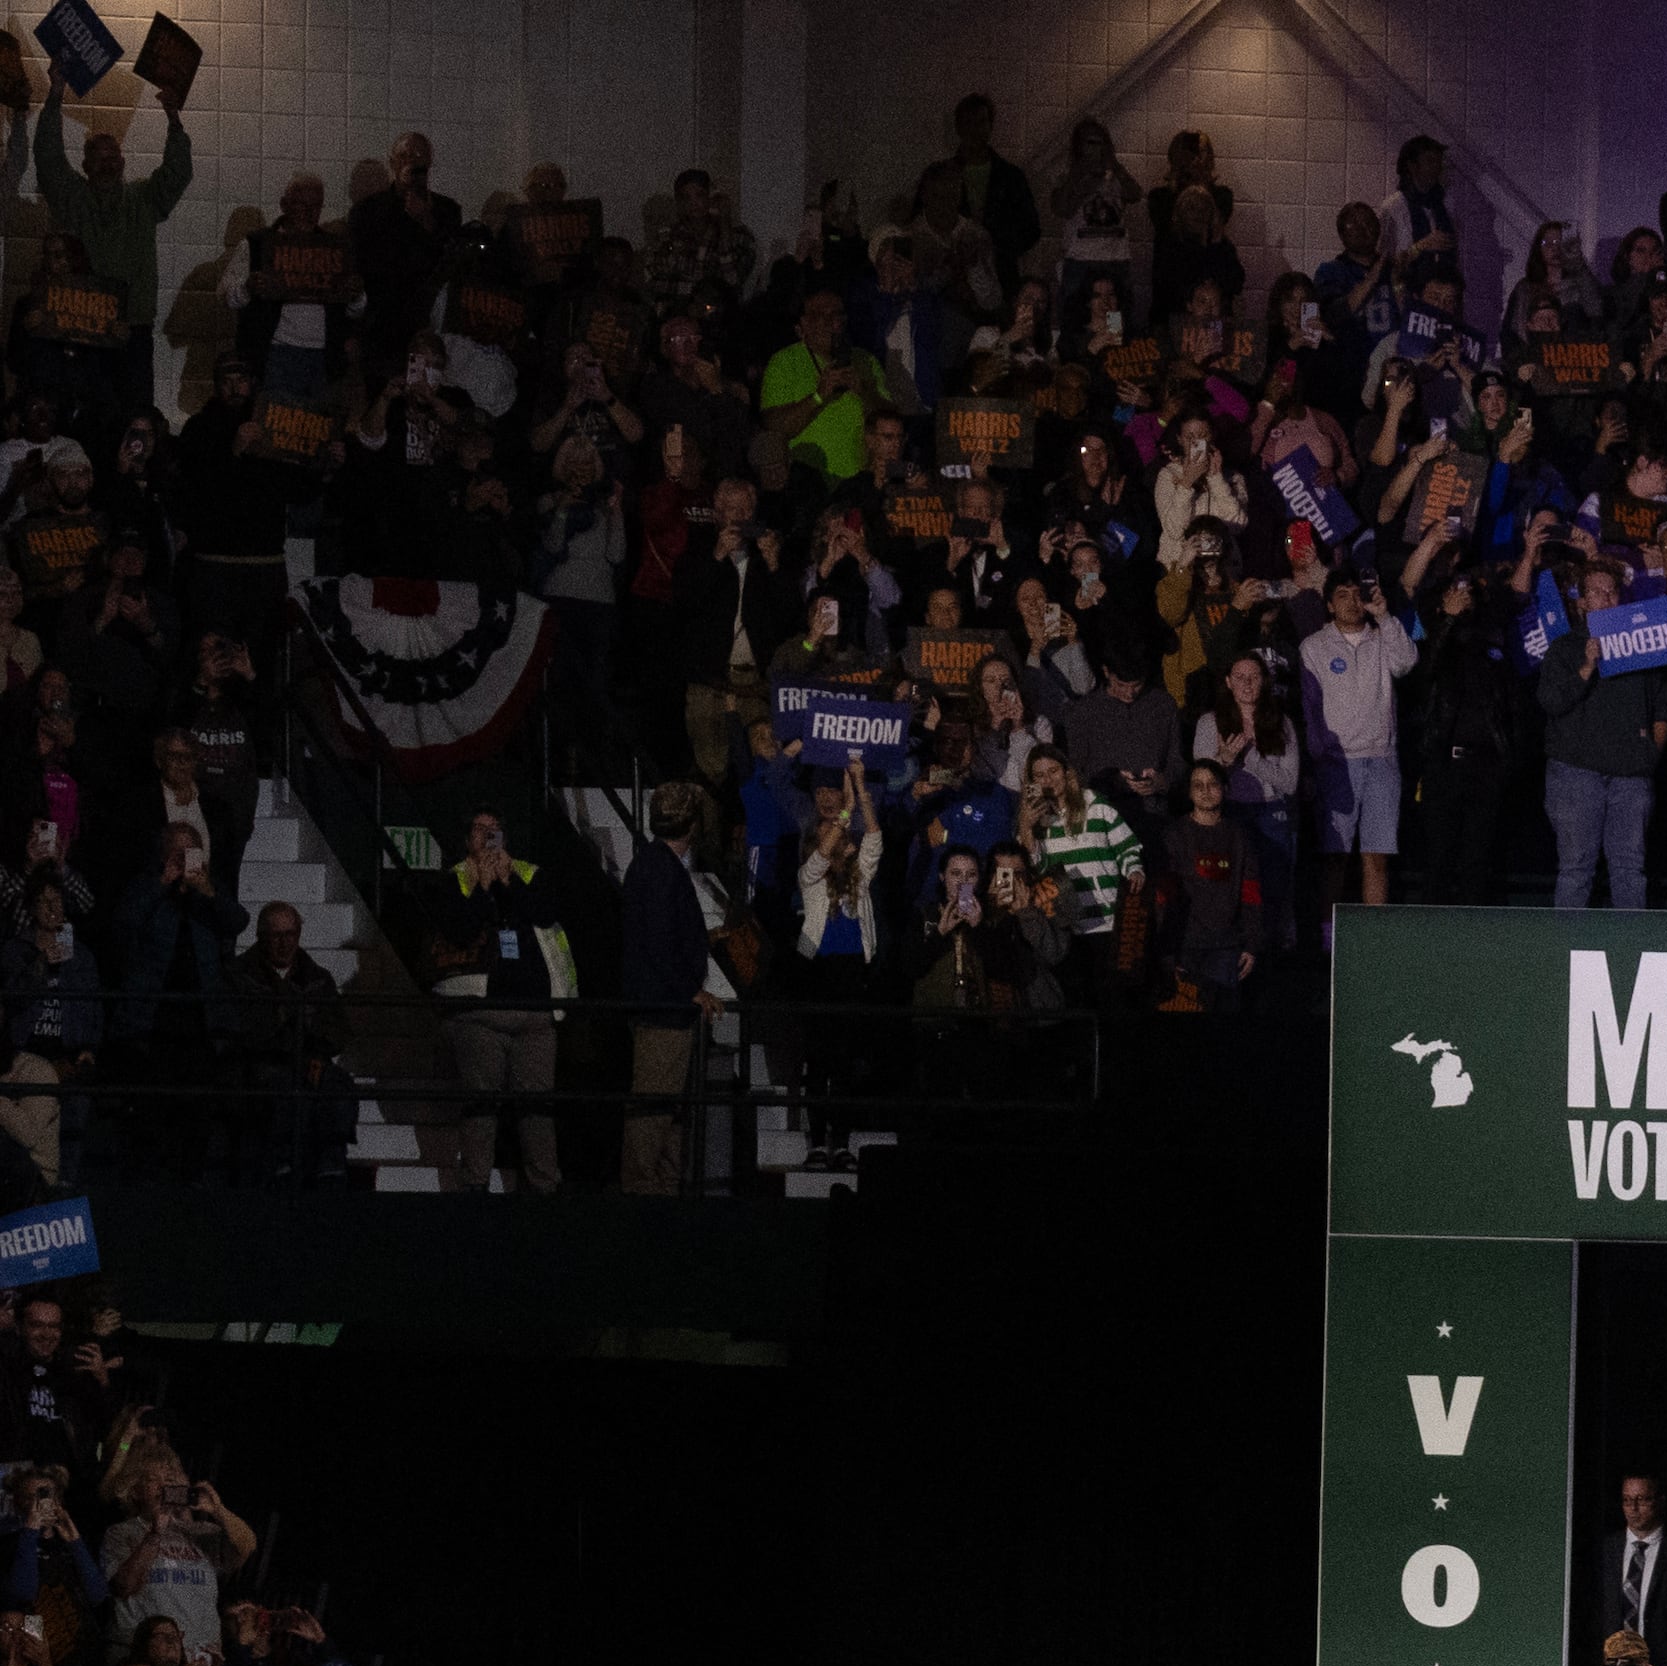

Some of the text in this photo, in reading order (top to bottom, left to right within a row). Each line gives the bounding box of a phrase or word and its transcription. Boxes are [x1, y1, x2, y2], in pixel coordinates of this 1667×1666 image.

[1543, 343, 1610, 368] HARRIS
[949, 412, 1019, 439] HARRIS
[1272, 463, 1336, 544] FREEDOM
[813, 713, 901, 745] FREEDOM
[0, 1216, 87, 1256] REEDOM
